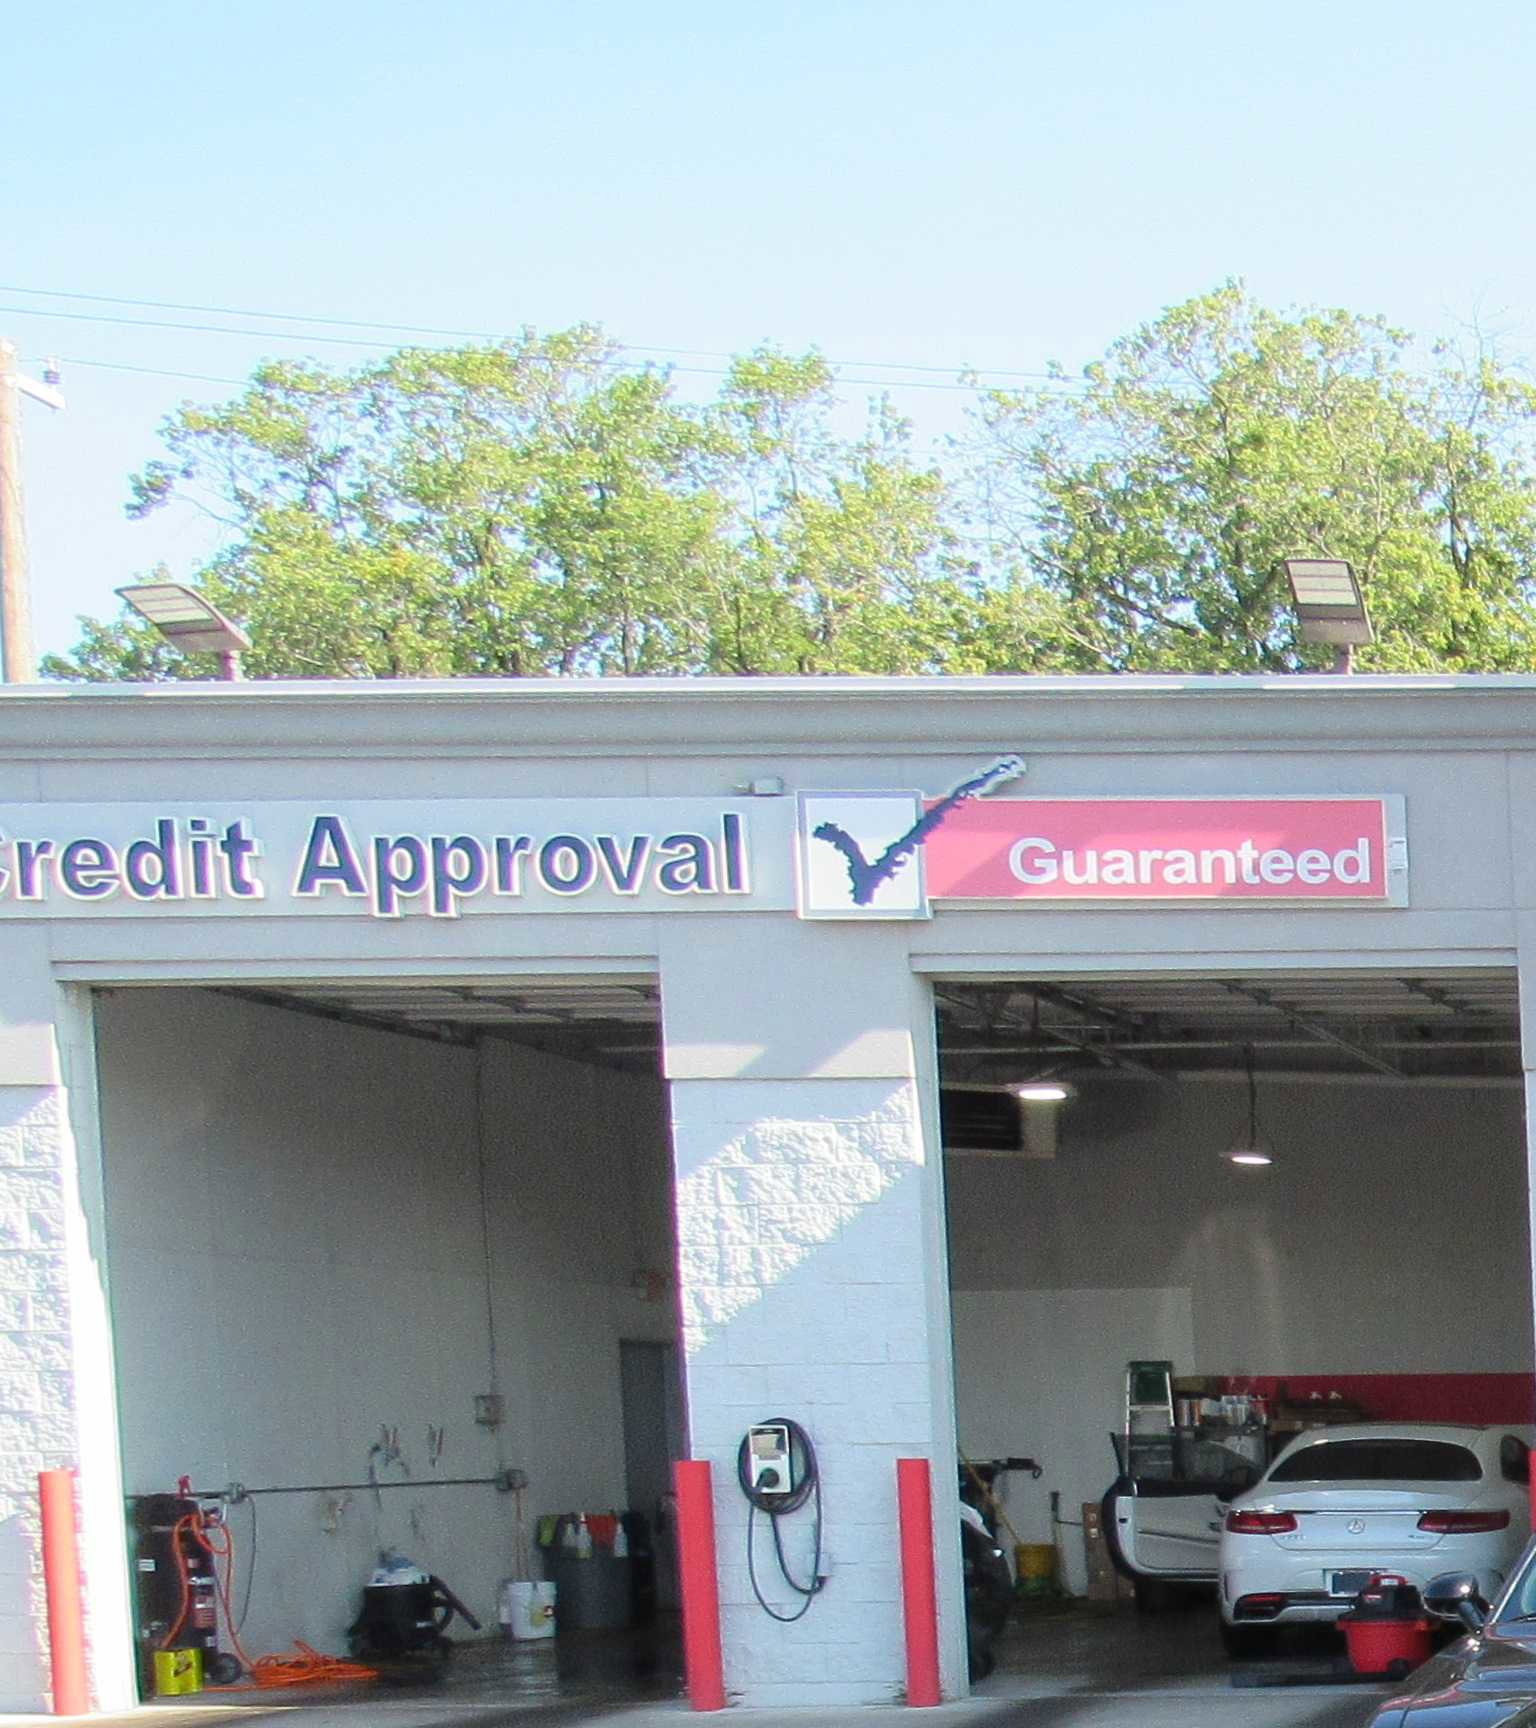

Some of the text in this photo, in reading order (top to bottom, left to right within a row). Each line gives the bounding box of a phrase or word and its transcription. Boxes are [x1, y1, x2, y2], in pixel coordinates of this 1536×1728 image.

[0, 812, 751, 918] redit Approval
[1008, 836, 1372, 886] Guaranteed
